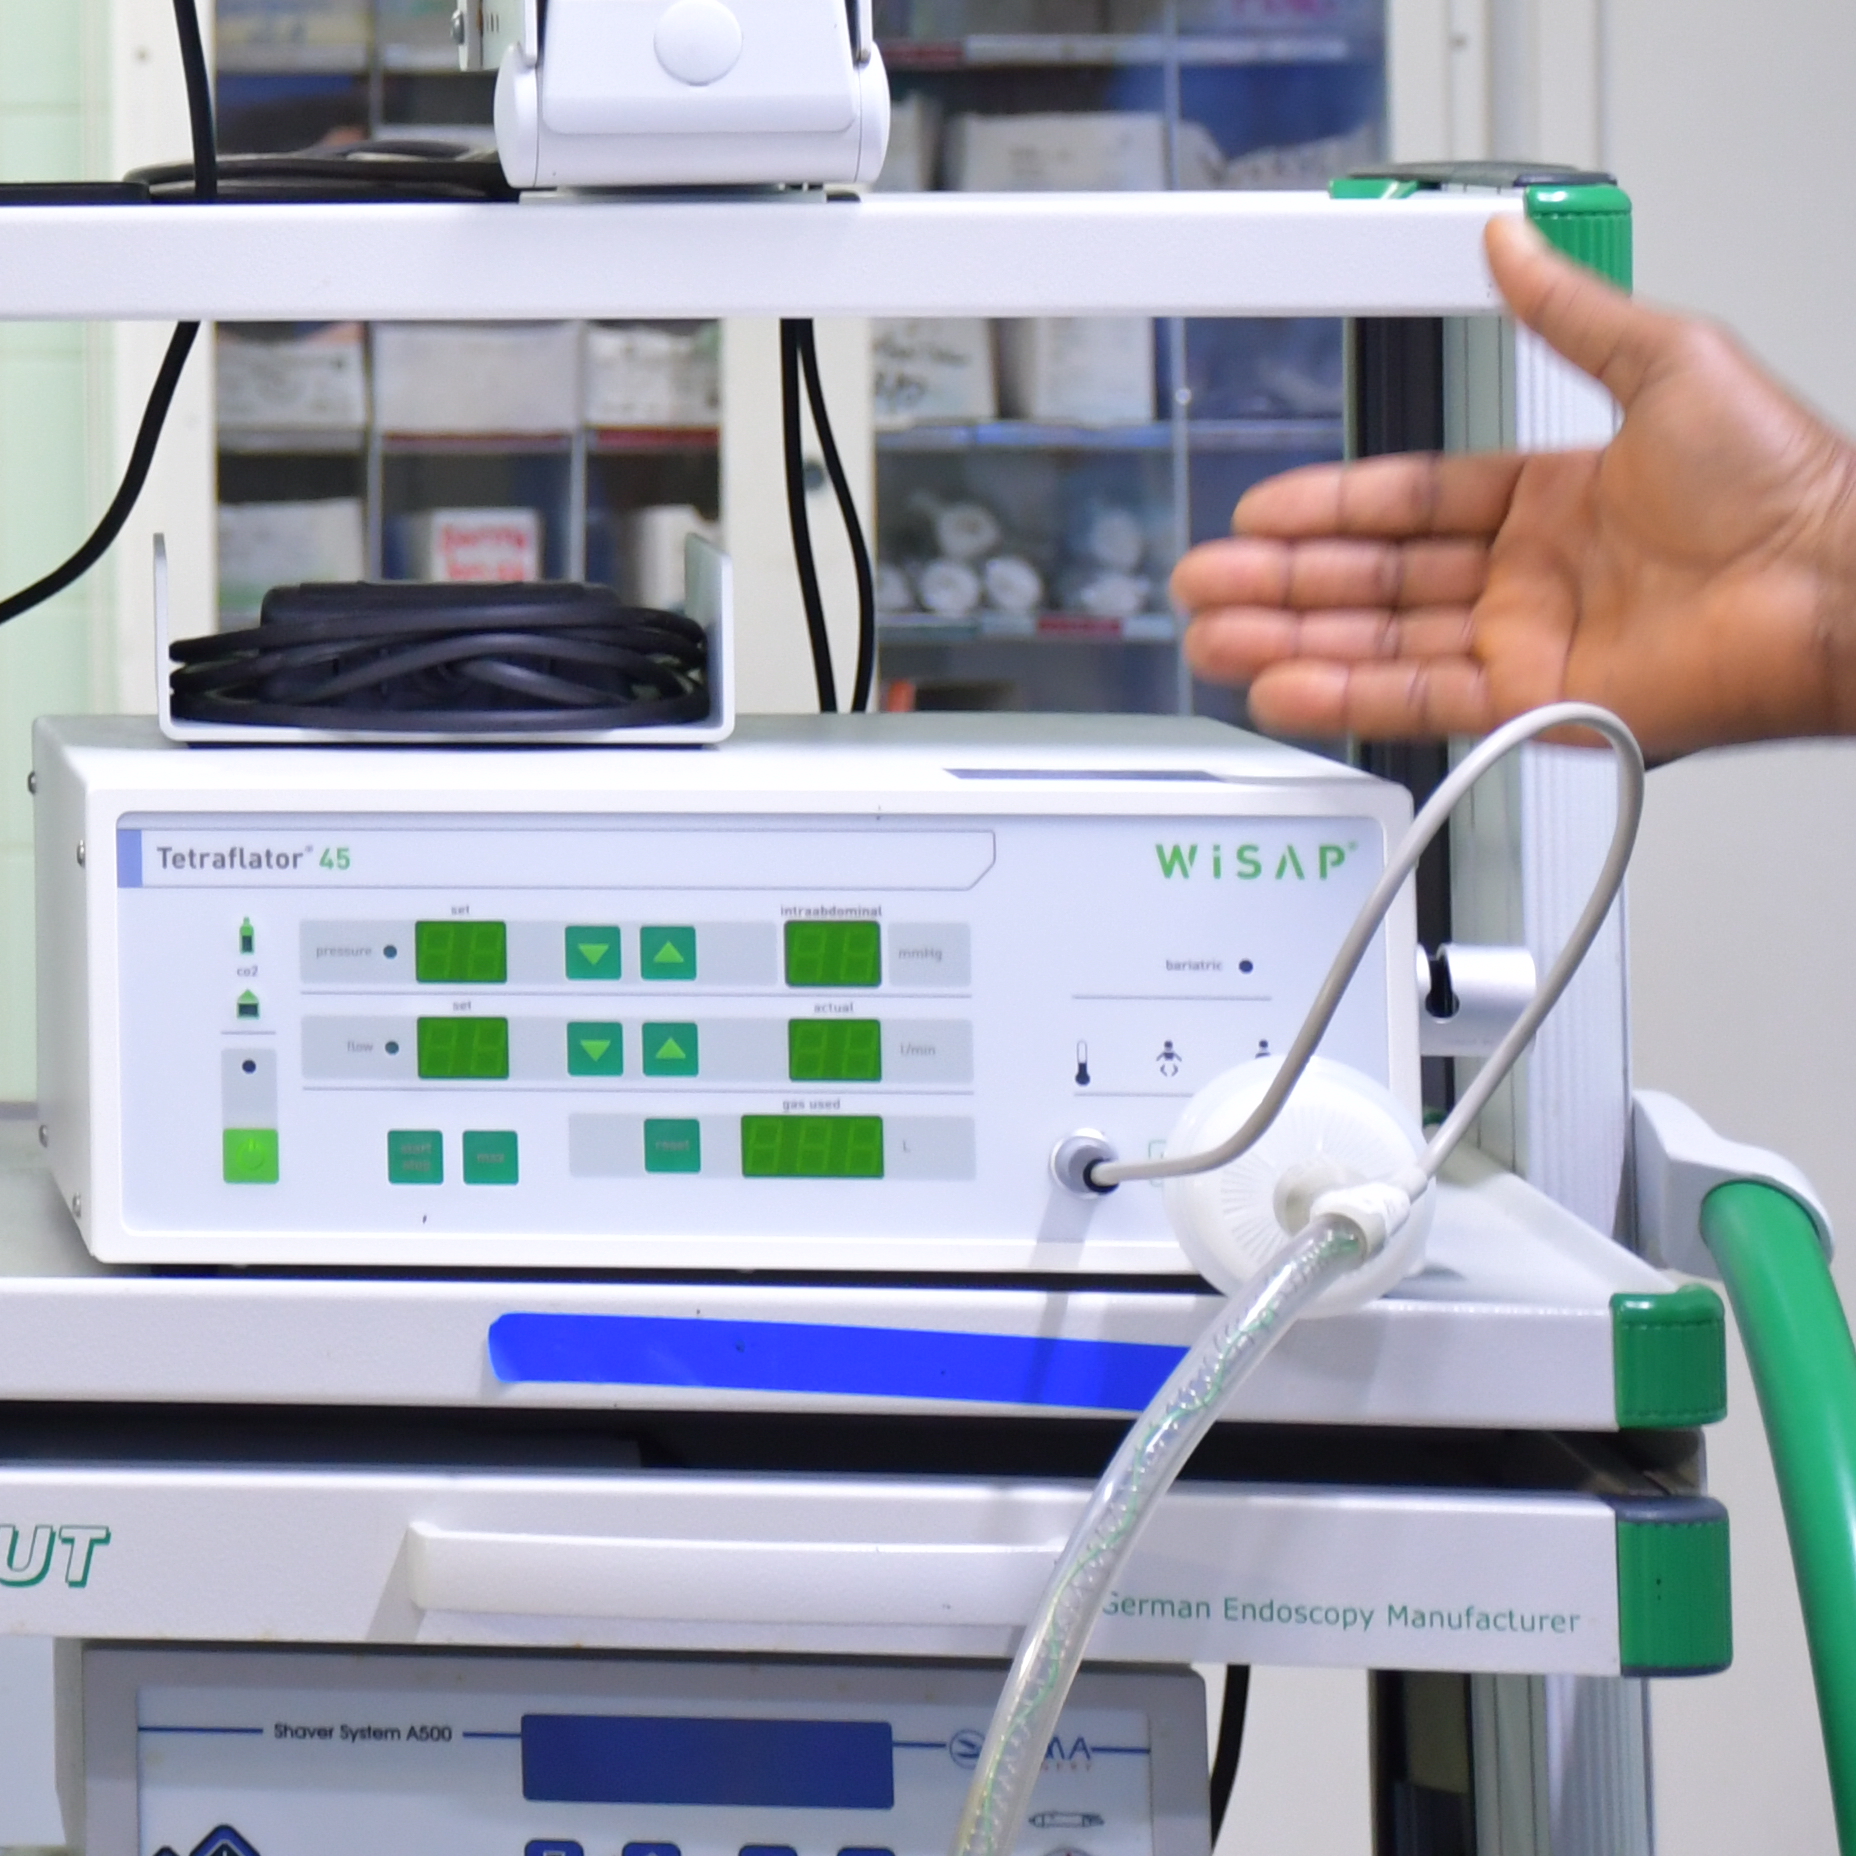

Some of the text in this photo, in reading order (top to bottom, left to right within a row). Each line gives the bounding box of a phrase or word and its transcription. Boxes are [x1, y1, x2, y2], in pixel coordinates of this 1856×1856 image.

[319, 846, 351, 871] 45
[450, 904, 471, 916] set
[780, 905, 883, 918] intraabdominal
[315, 946, 373, 959] pressure
[898, 946, 944, 962] mmHg
[1165, 959, 1223, 972] bariatric
[452, 1000, 472, 1012] set
[813, 1001, 855, 1014] actual
[346, 1040, 374, 1053] flow
[782, 1098, 841, 1113] gas used
[1224, 1596, 1375, 1631] Endoscopy
[1388, 1604, 1581, 1633] Manufacturer
[273, 1722, 453, 1743] Shaver System A500
